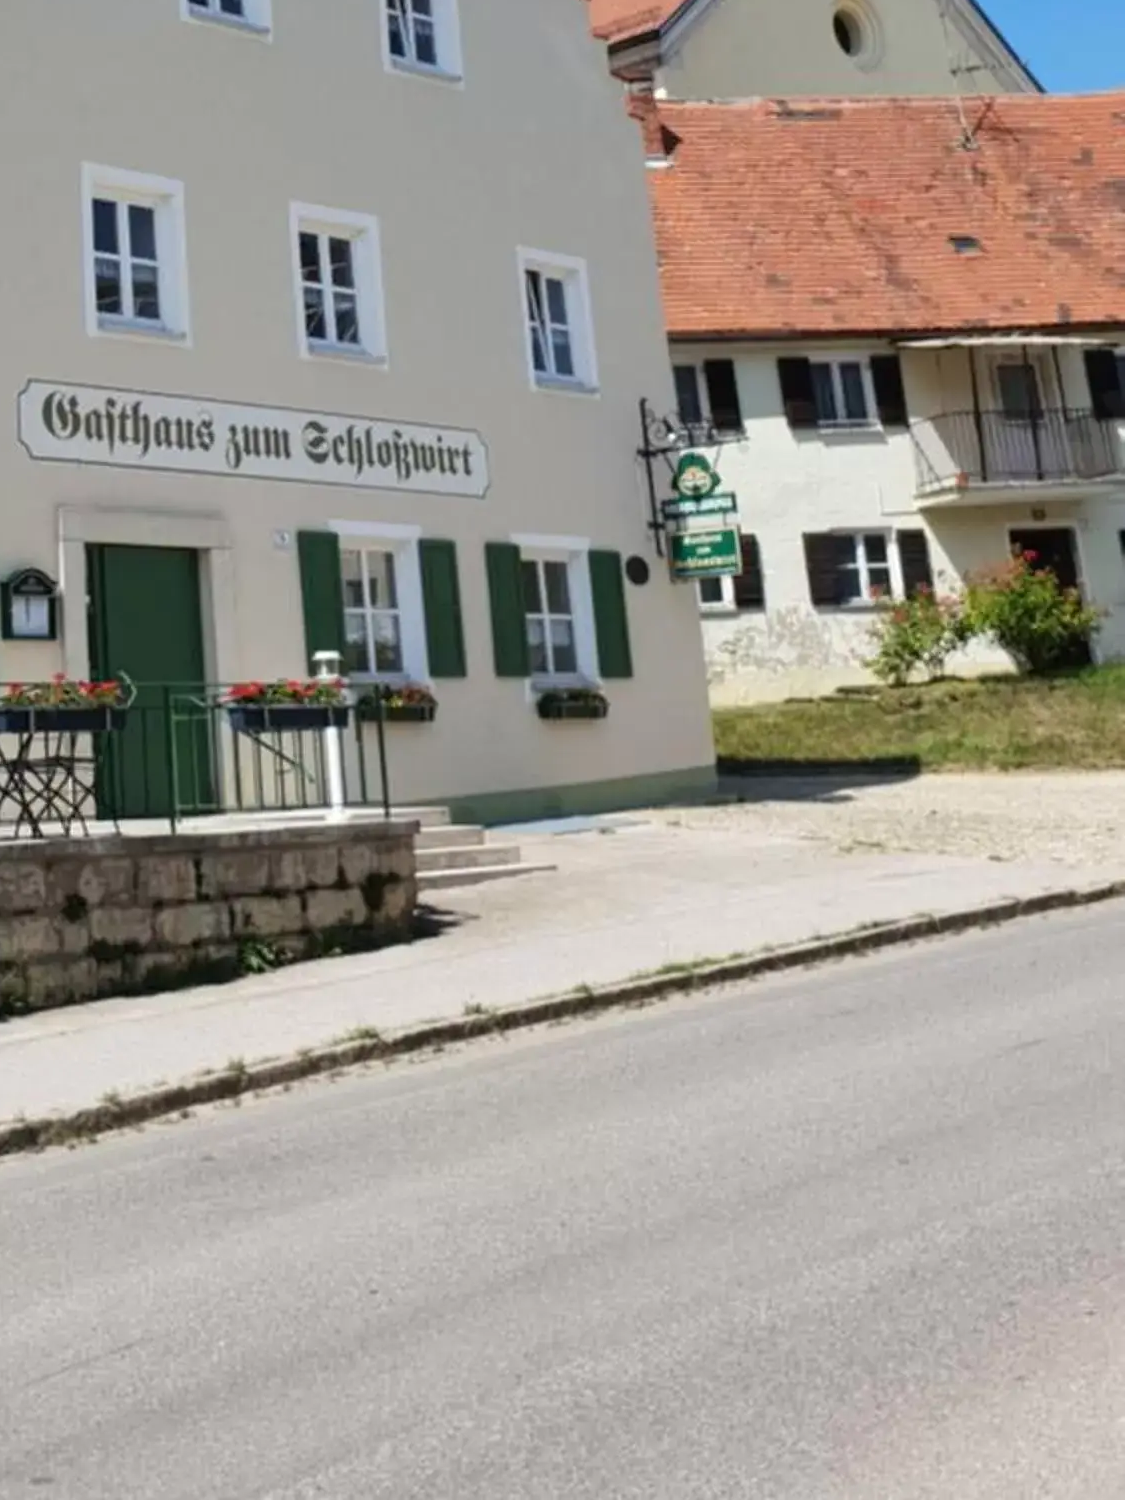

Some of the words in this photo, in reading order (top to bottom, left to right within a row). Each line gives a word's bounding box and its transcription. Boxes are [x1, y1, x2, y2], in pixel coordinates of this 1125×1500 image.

[41, 390, 216, 459] Gasthaus
[226, 423, 292, 470] zum
[301, 420, 473, 481] Schloßwirt
